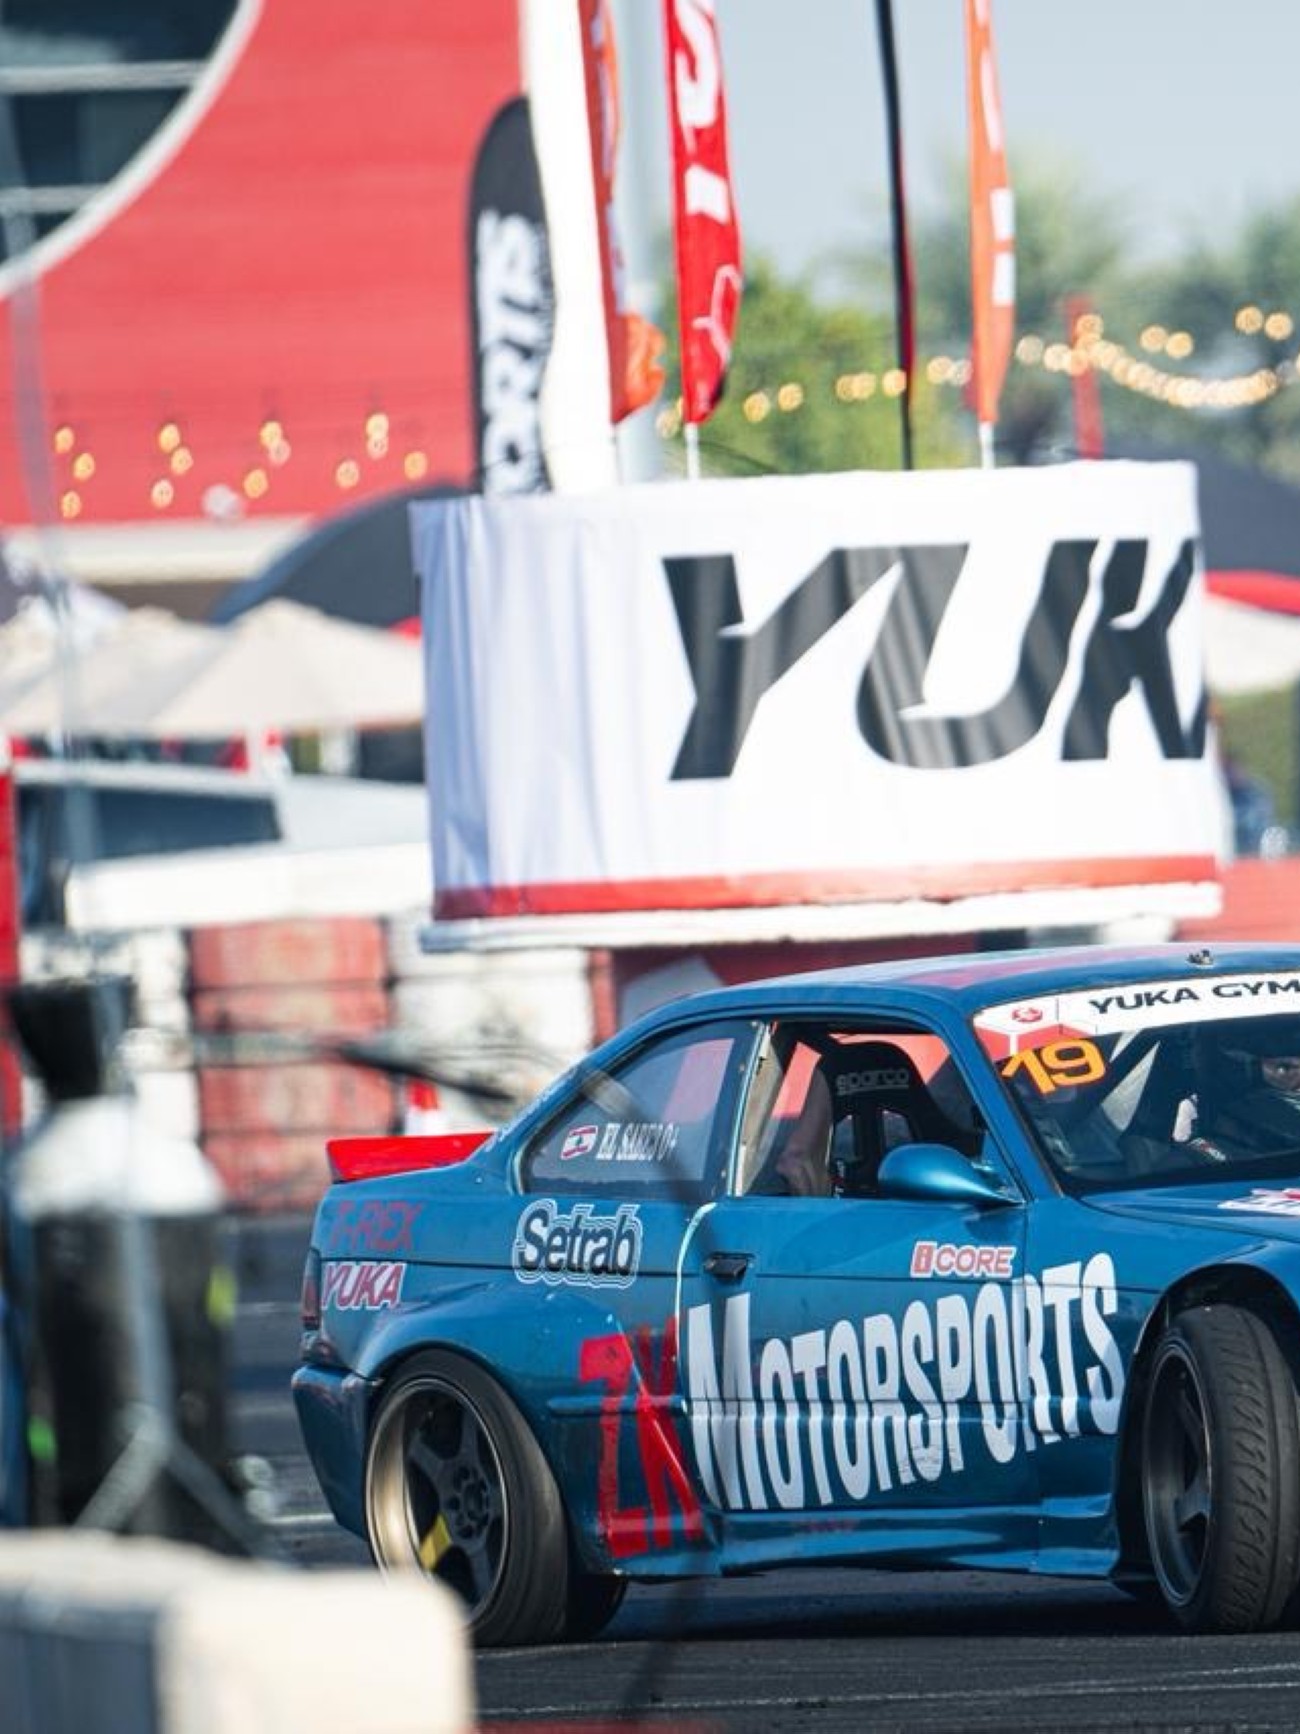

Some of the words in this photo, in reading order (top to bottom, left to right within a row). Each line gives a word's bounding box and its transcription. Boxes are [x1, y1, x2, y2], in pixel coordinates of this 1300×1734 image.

[477, 208, 551, 493] ORTIS
[662, 538, 1204, 781] YUK
[1089, 984, 1201, 1015] YUKA
[1001, 1038, 1106, 1095] 19
[330, 1202, 421, 1251] T-REX
[515, 1202, 640, 1283] Setrab
[322, 1262, 406, 1310] YUKA
